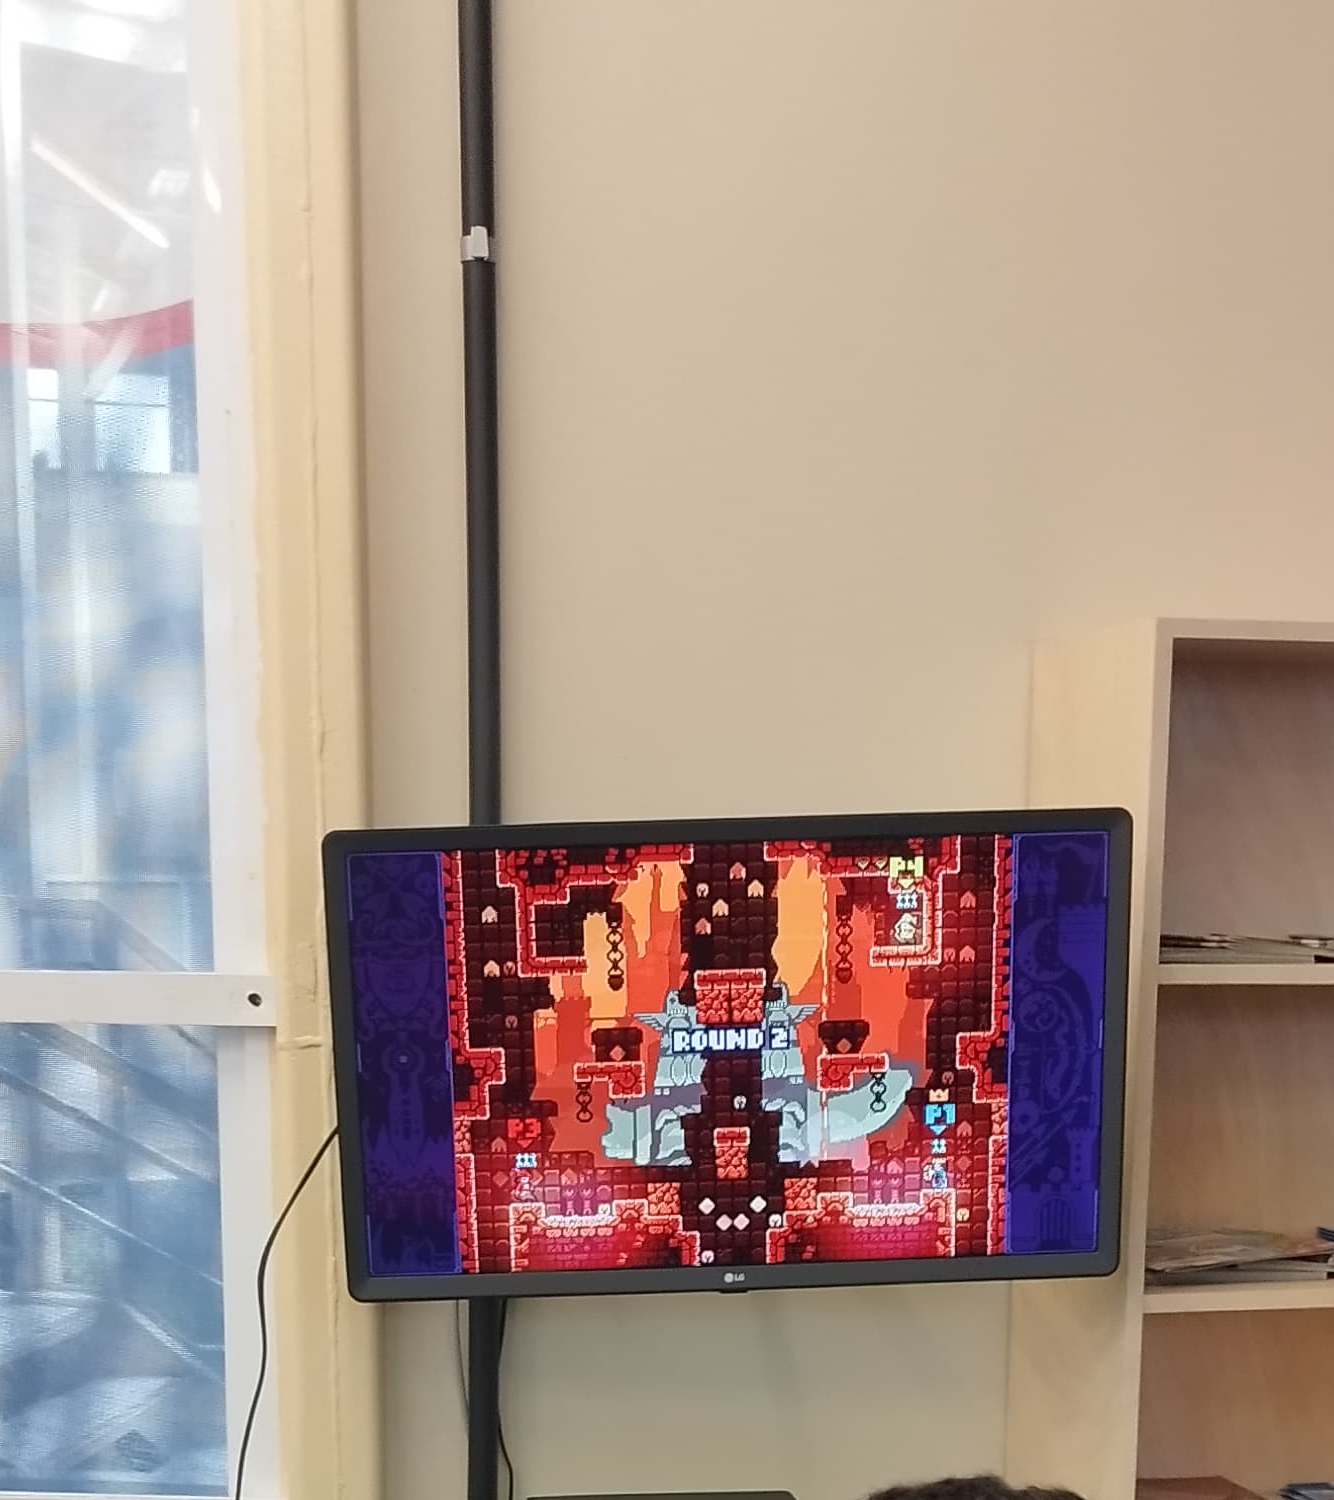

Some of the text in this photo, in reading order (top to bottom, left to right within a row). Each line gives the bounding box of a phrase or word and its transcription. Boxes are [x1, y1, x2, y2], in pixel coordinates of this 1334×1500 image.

[889, 856, 924, 878] P4
[673, 1027, 788, 1052] ROUND 2
[925, 1103, 955, 1125] P1
[508, 1118, 541, 1138] P3
